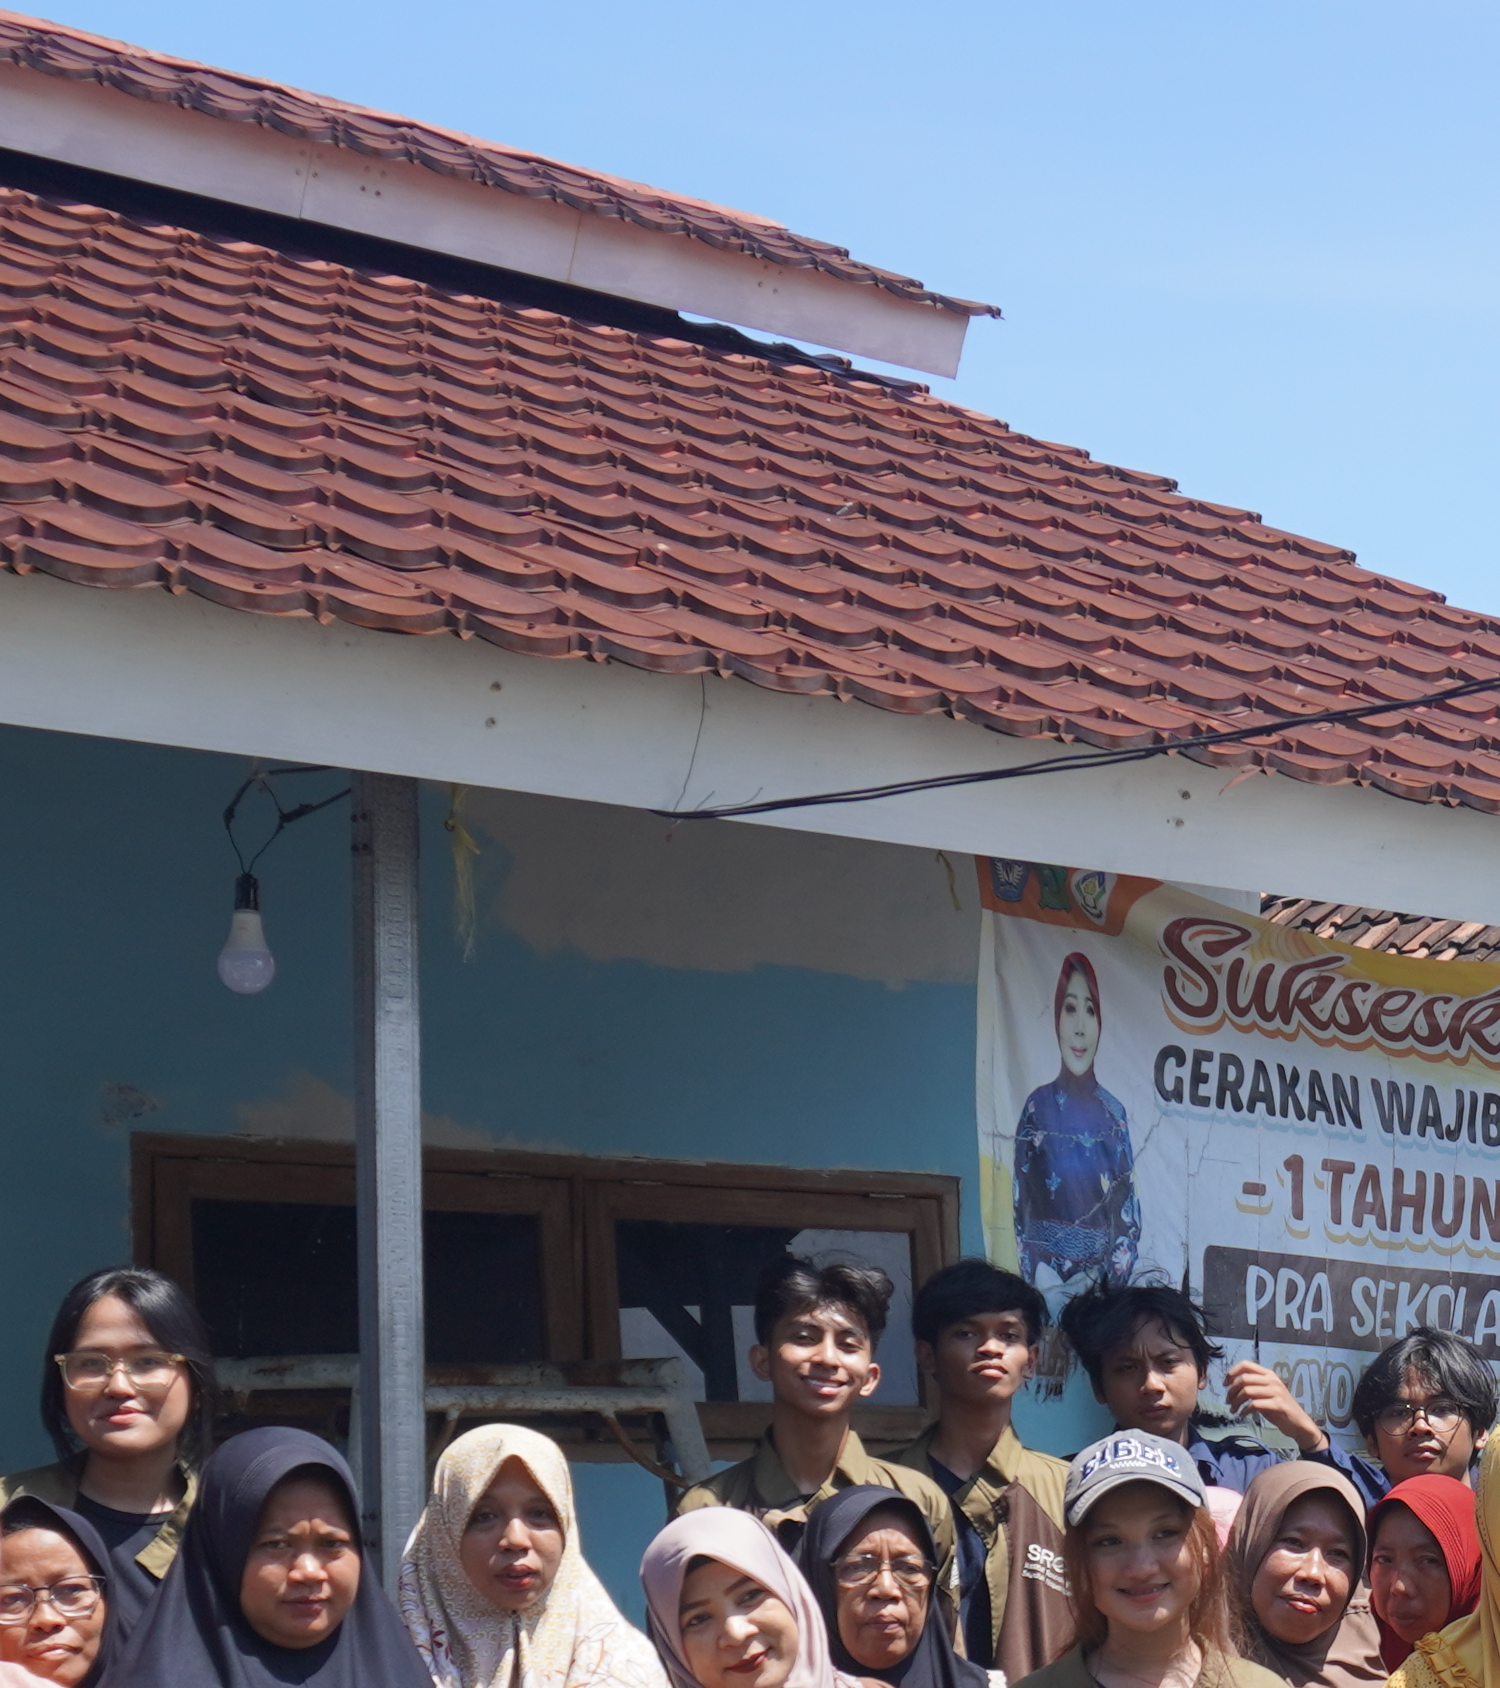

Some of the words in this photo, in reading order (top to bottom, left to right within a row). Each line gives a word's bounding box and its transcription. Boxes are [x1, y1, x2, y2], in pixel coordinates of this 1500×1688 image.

[1153, 1044, 1363, 1131] GERAKAN
[1283, 1154, 1304, 1221] 1
[1245, 1264, 1335, 1333] PRA
